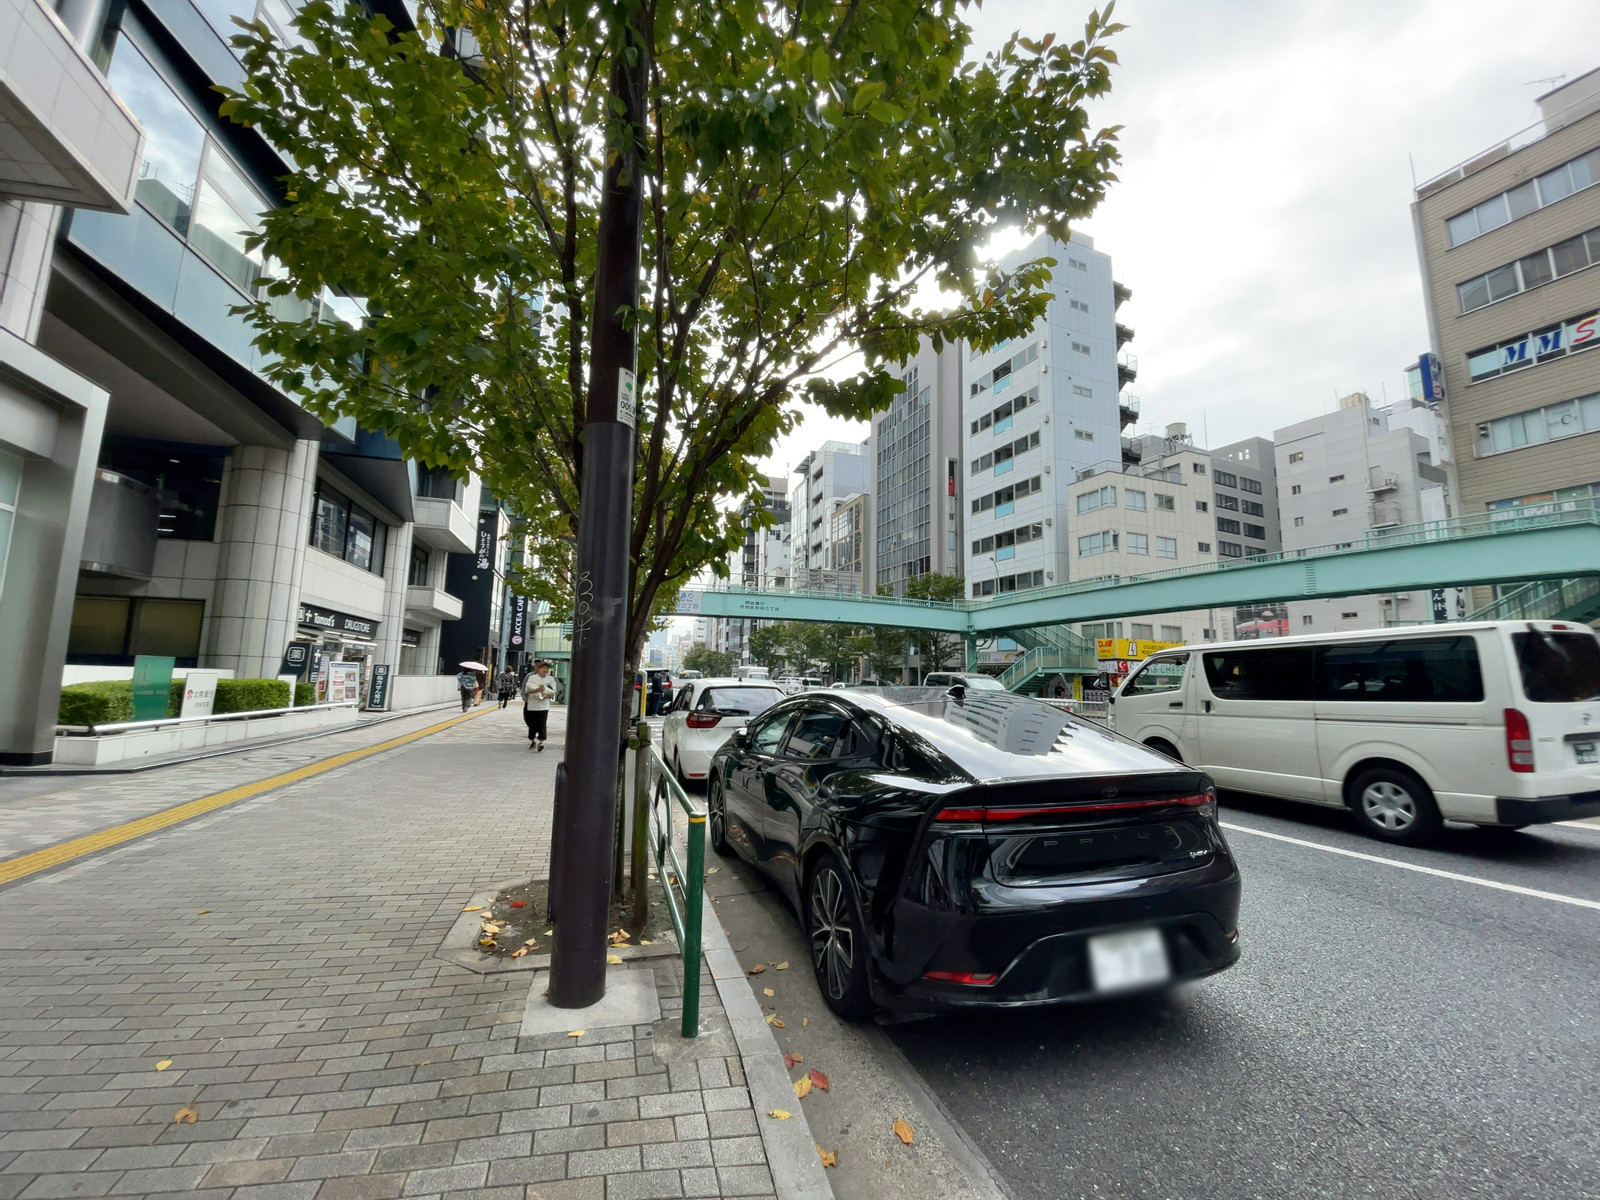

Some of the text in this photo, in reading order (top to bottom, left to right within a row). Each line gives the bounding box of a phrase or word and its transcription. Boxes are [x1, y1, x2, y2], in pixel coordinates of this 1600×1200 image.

[1503, 318, 1597, 366] MMS
[313, 612, 335, 627] Tomod's
[344, 619, 370, 633] DRUGSTORE
[515, 612, 523, 635] ACCEA
